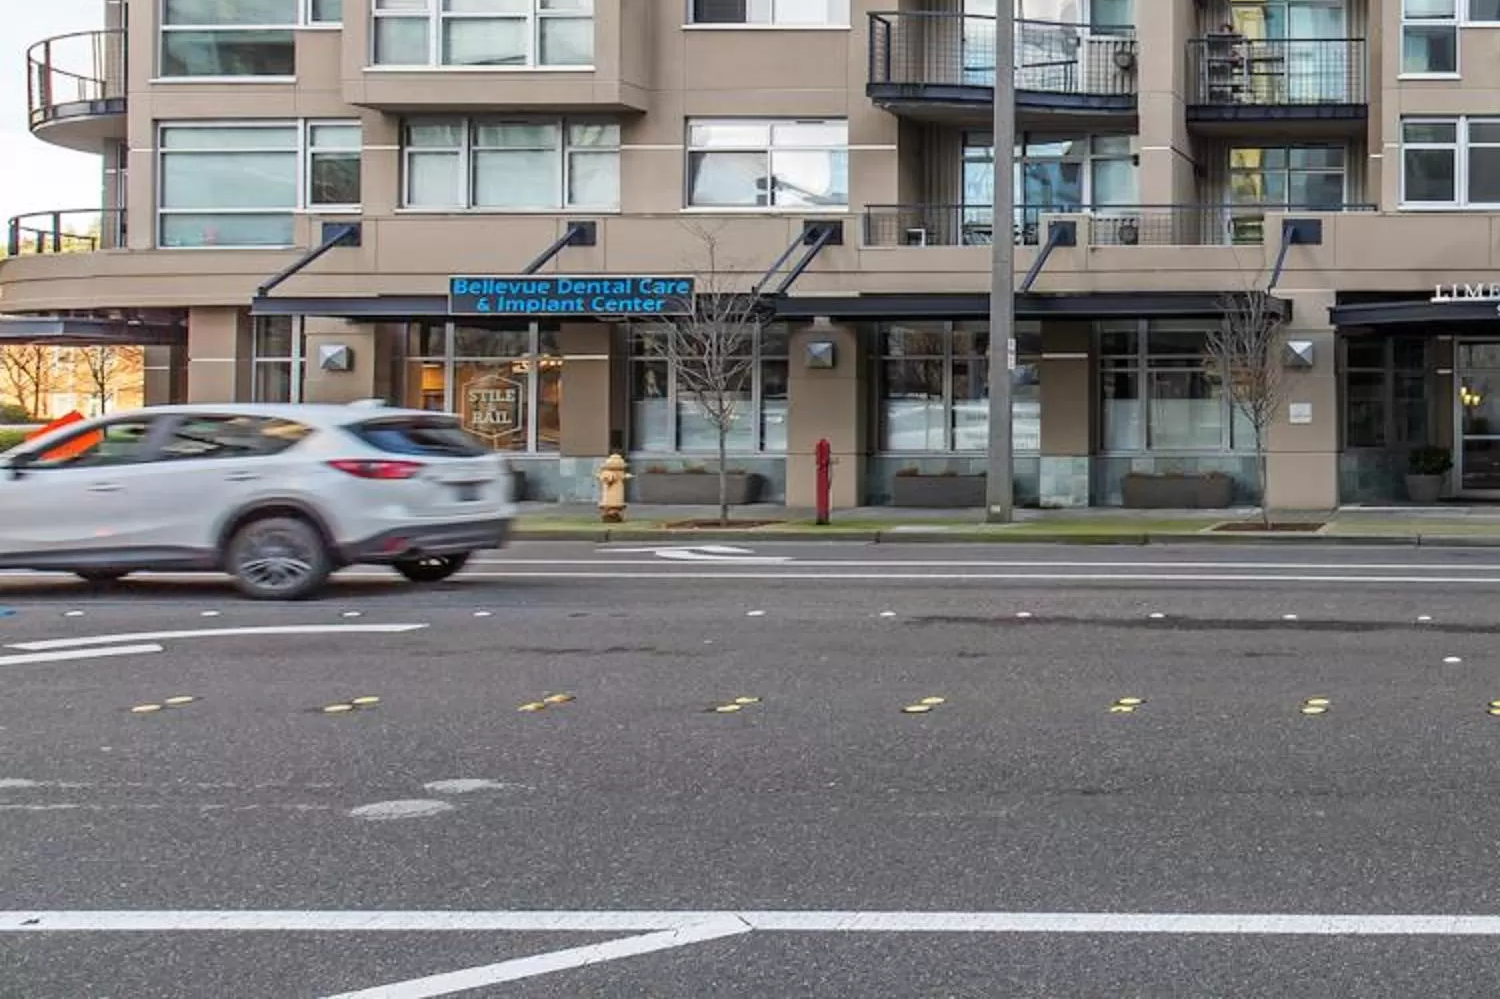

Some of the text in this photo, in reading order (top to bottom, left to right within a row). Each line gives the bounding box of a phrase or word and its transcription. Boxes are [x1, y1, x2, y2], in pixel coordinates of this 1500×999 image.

[453, 277, 690, 294] Bellevue Dental Care
[476, 296, 665, 313] & Implant Center
[468, 388, 516, 402] STILE
[472, 410, 512, 424] RAIL
